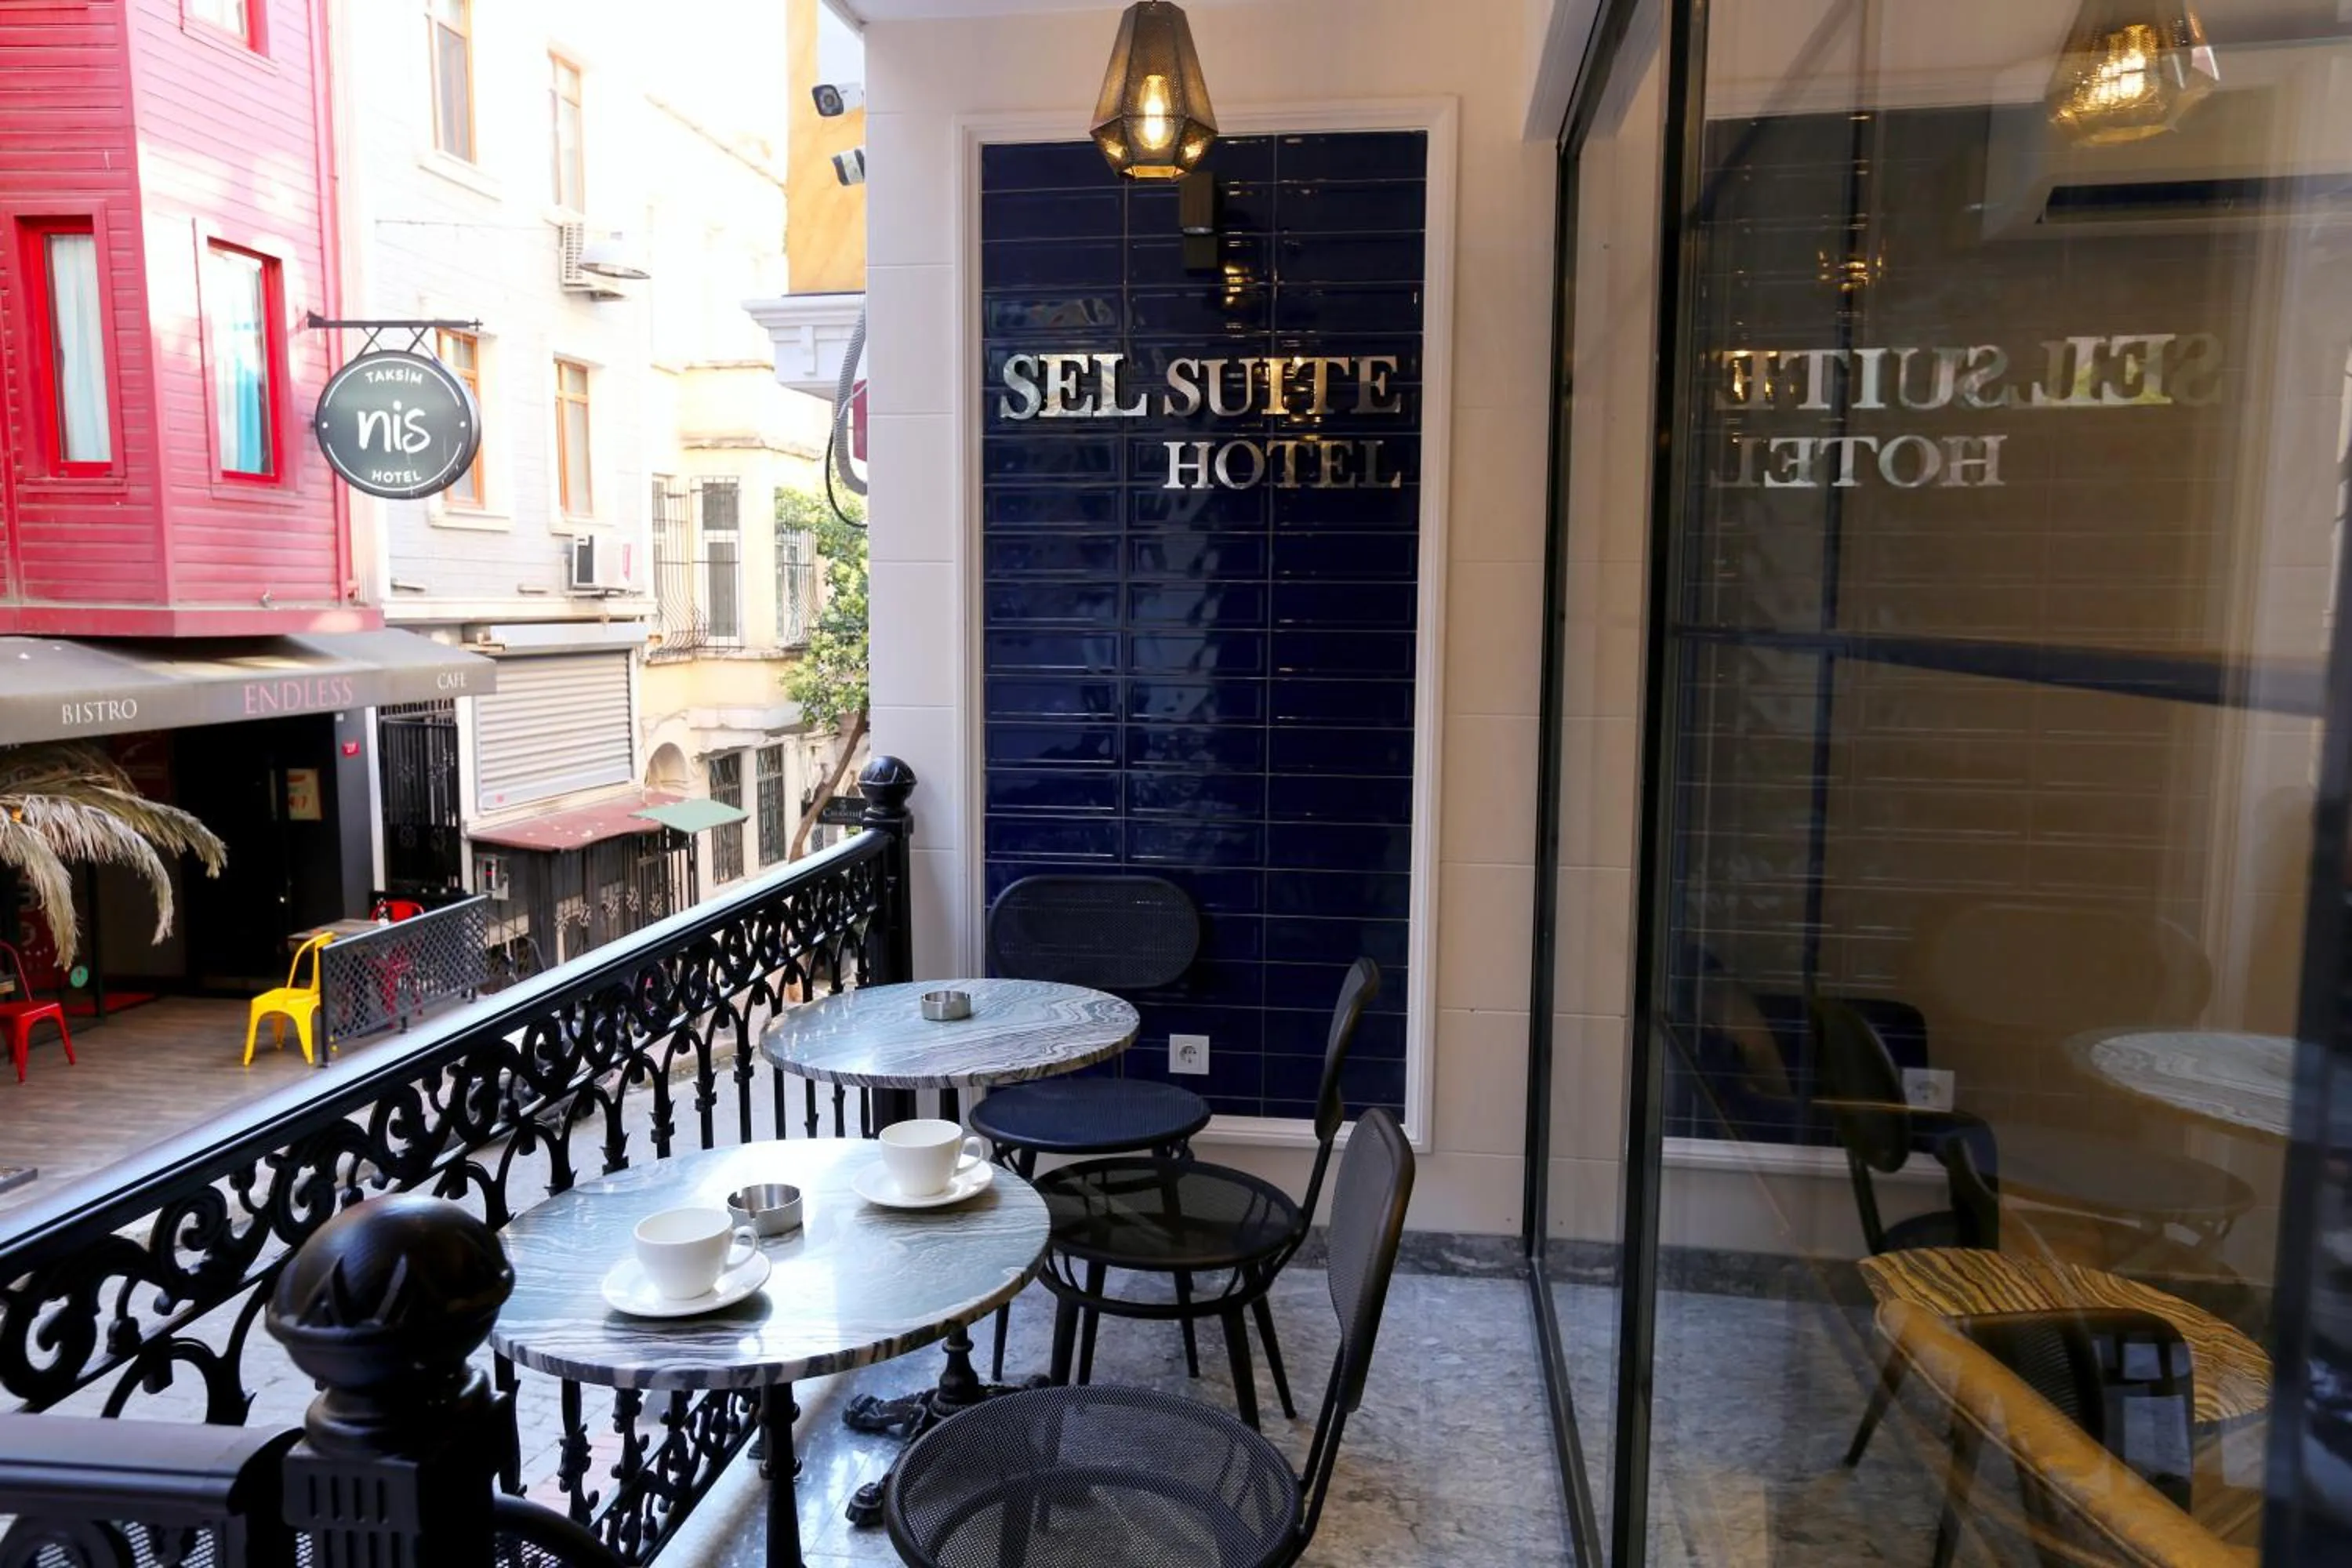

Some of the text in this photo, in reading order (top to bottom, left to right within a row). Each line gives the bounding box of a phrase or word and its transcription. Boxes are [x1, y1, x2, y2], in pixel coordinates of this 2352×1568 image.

[1000, 353, 1402, 420] SEL SUITE
[358, 400, 430, 454] nis
[372, 470, 422, 484] HOTEL
[1163, 440, 1402, 489] HOTEL
[62, 699, 137, 725] BISTRO
[244, 677, 354, 715] ENDLESS
